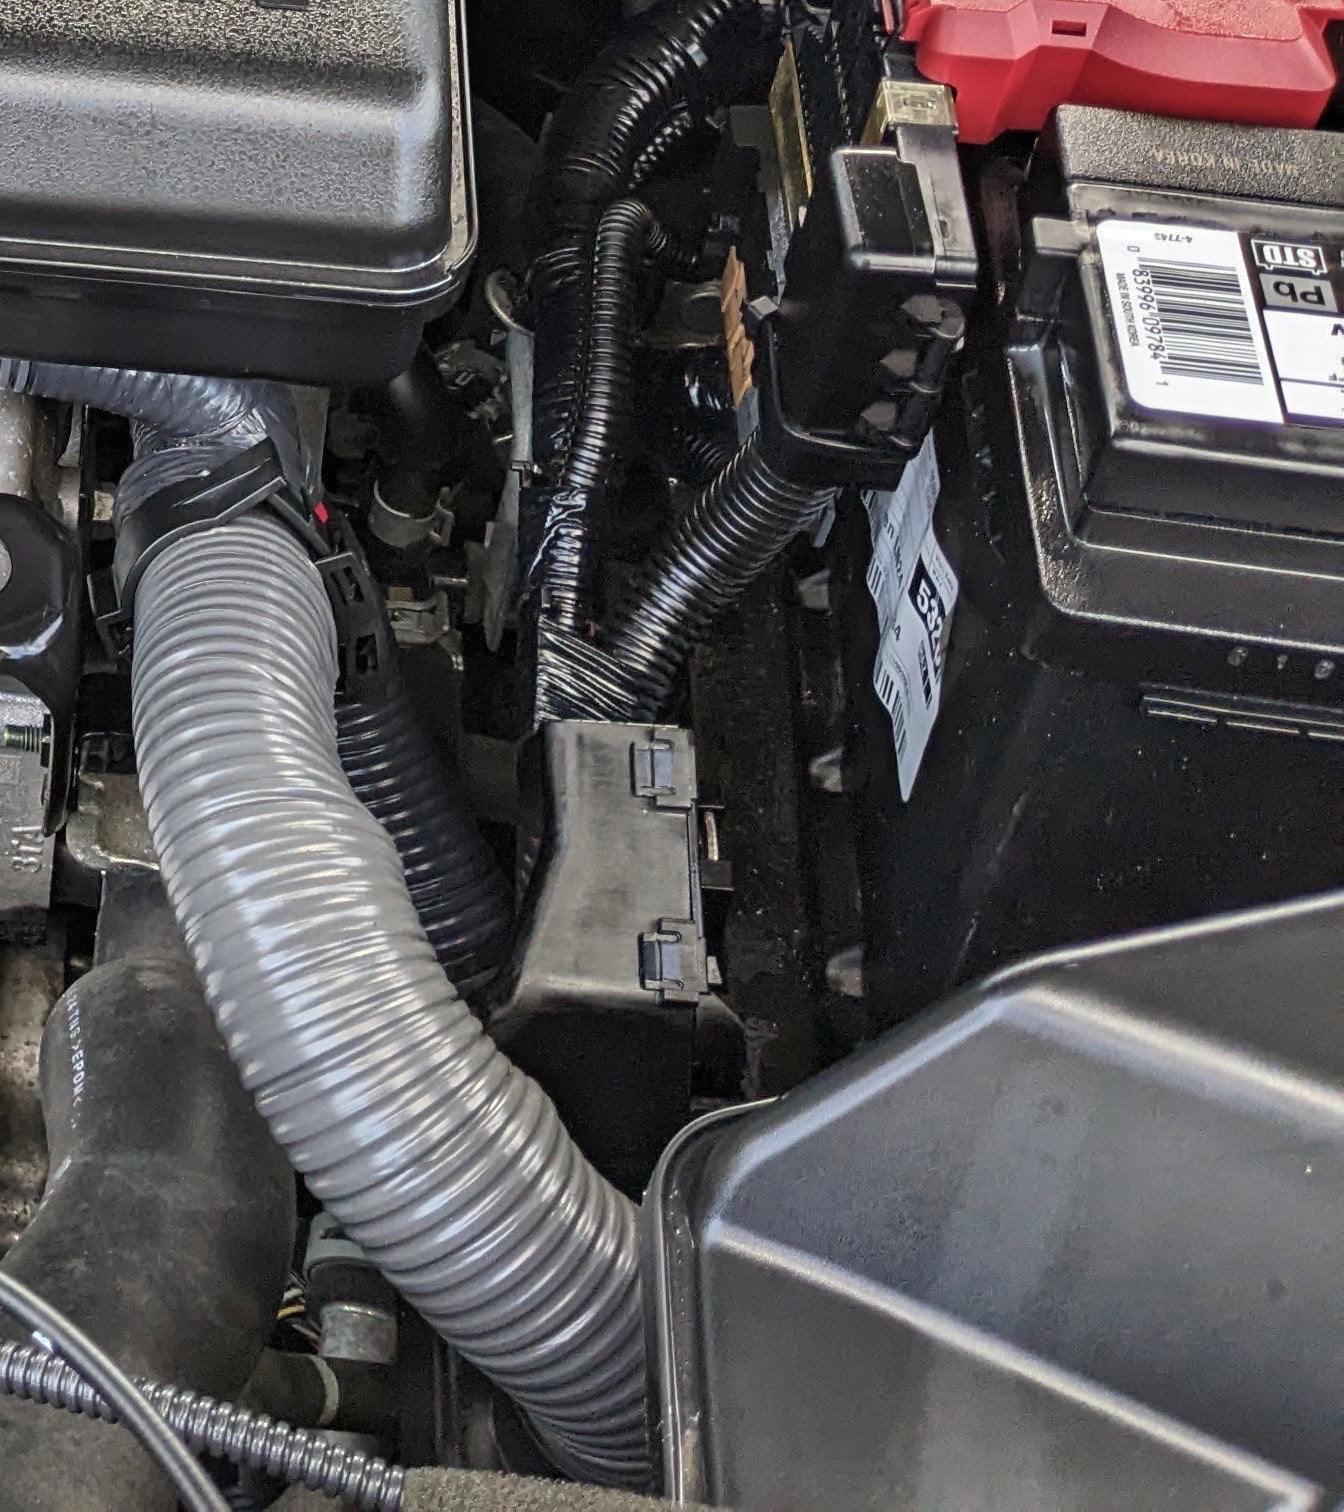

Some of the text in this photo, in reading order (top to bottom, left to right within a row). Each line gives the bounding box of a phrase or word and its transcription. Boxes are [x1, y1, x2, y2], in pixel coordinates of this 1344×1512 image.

[1264, 245, 1316, 266] STD
[1132, 268, 1155, 311] 83996
[1272, 280, 1327, 305] Pb
[1142, 316, 1167, 360] 09784
